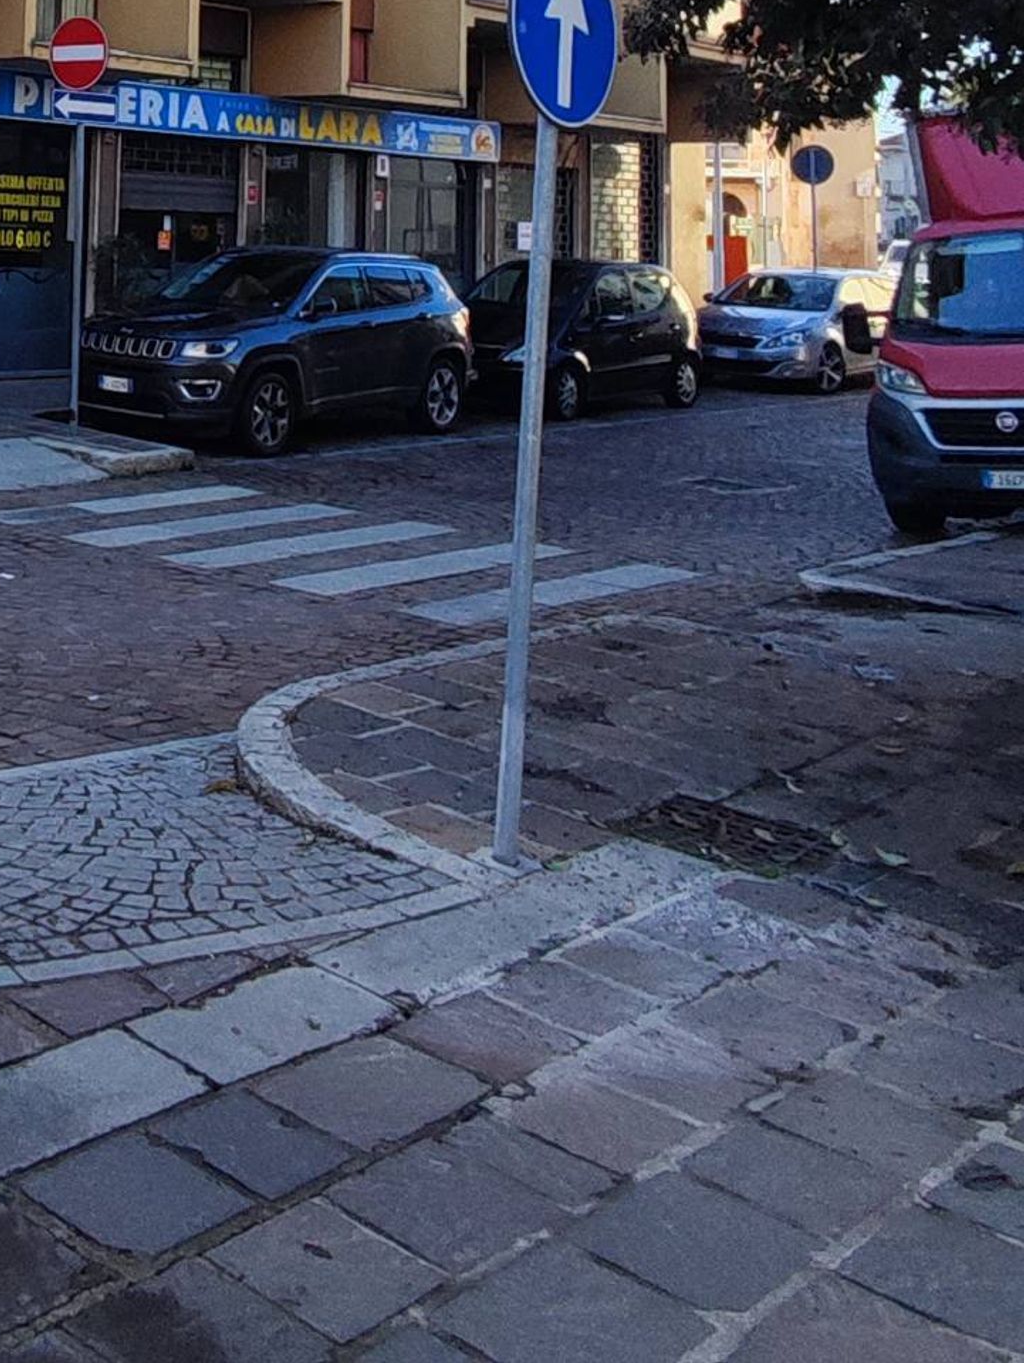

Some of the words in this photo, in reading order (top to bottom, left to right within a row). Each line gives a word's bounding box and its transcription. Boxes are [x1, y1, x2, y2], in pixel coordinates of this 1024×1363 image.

[13, 75, 209, 132] PIERIA
[216, 111, 230, 132] A
[235, 113, 276, 136] CASA
[279, 117, 296, 138] DI
[298, 106, 384, 146] LARA
[26, 176, 65, 191] OFFERTA
